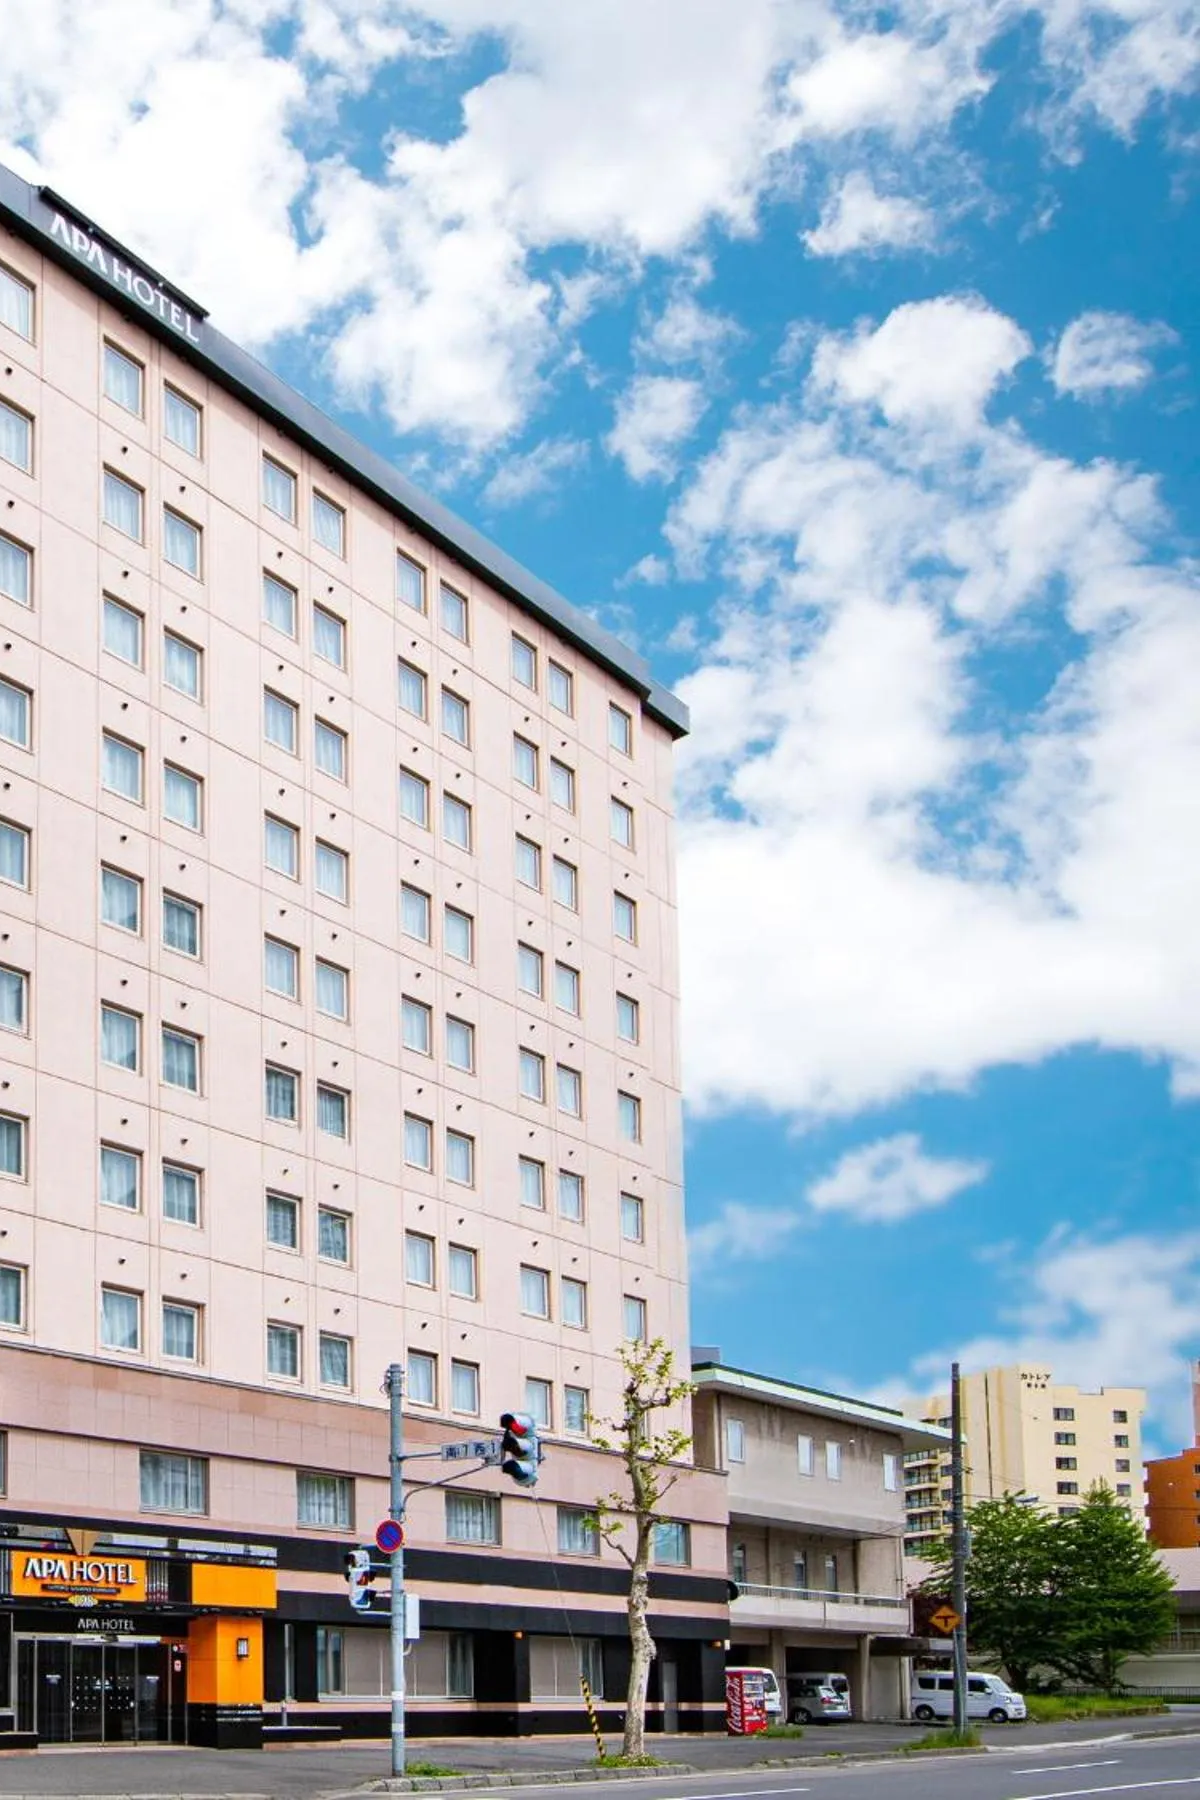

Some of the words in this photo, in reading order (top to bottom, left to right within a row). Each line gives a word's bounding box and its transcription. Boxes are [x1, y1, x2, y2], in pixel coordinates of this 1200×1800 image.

[50, 212, 108, 275] APA
[112, 257, 199, 343] HOTEL
[25, 1557, 69, 1580] APA
[72, 1560, 137, 1584] HOTEL
[77, 1618, 100, 1630] APA
[101, 1619, 136, 1632] HOTEL
